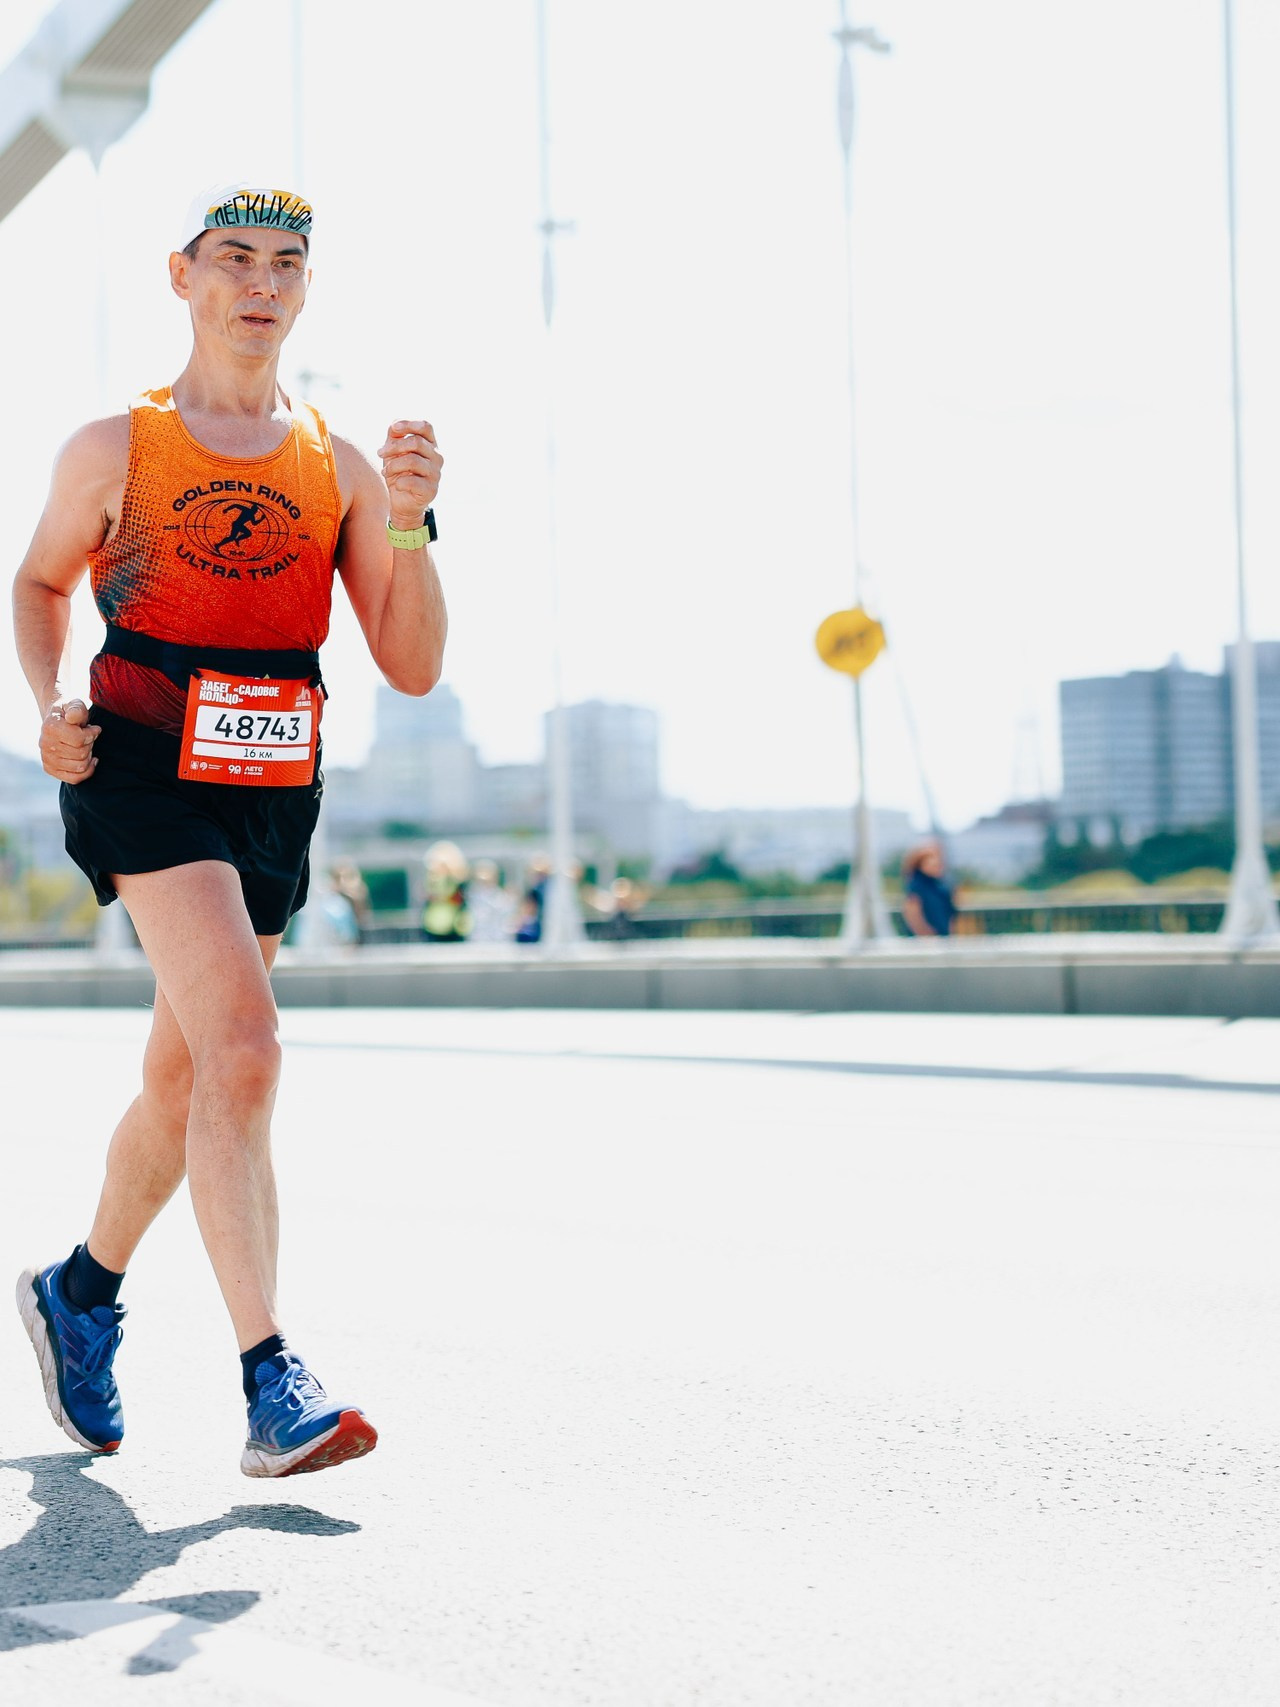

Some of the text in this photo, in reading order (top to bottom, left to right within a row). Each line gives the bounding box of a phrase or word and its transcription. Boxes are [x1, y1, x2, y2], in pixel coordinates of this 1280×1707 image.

[214, 193, 291, 227] ЛЁГКИХ
[172, 480, 301, 520] GOLDEN RING
[176, 543, 300, 581] ULTRA TRAIL
[199, 690, 244, 706] КОЛЬЦО»
[200, 680, 280, 698] ЗАБЕГ «САДОВОЕ
[214, 713, 301, 741] 48743
[243, 748, 256, 758] 16
